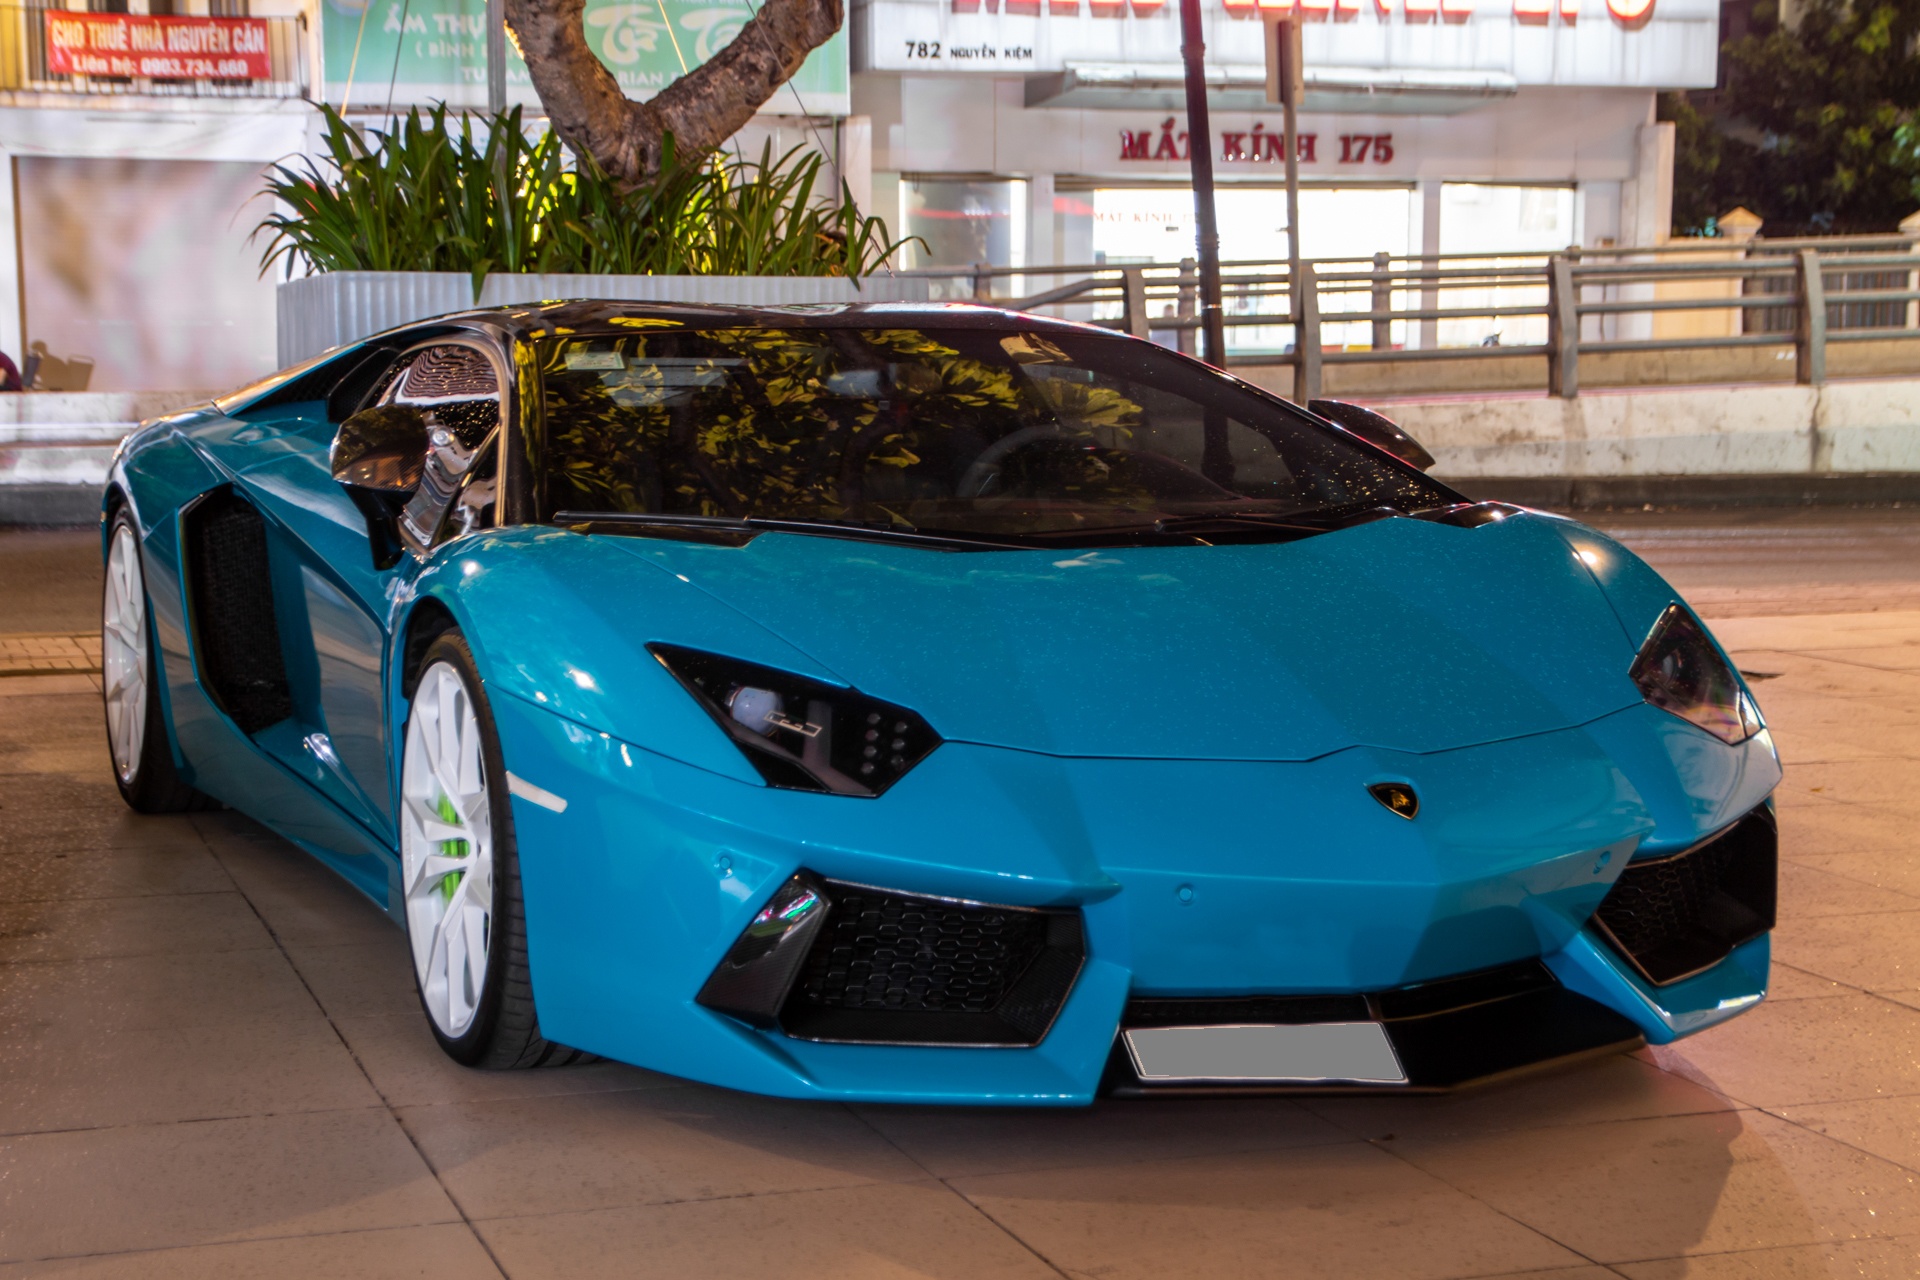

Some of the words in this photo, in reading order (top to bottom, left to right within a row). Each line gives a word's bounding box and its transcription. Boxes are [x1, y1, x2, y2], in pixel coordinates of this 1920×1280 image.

[52, 19, 84, 48] CHO
[87, 18, 127, 51] THUÊ
[131, 19, 164, 52] NHÀ
[167, 21, 229, 53] NGUYÊN
[232, 21, 265, 53] CĂN
[905, 40, 941, 59] 782
[1221, 122, 1317, 162] KÍNH
[1338, 133, 1394, 163] 175
